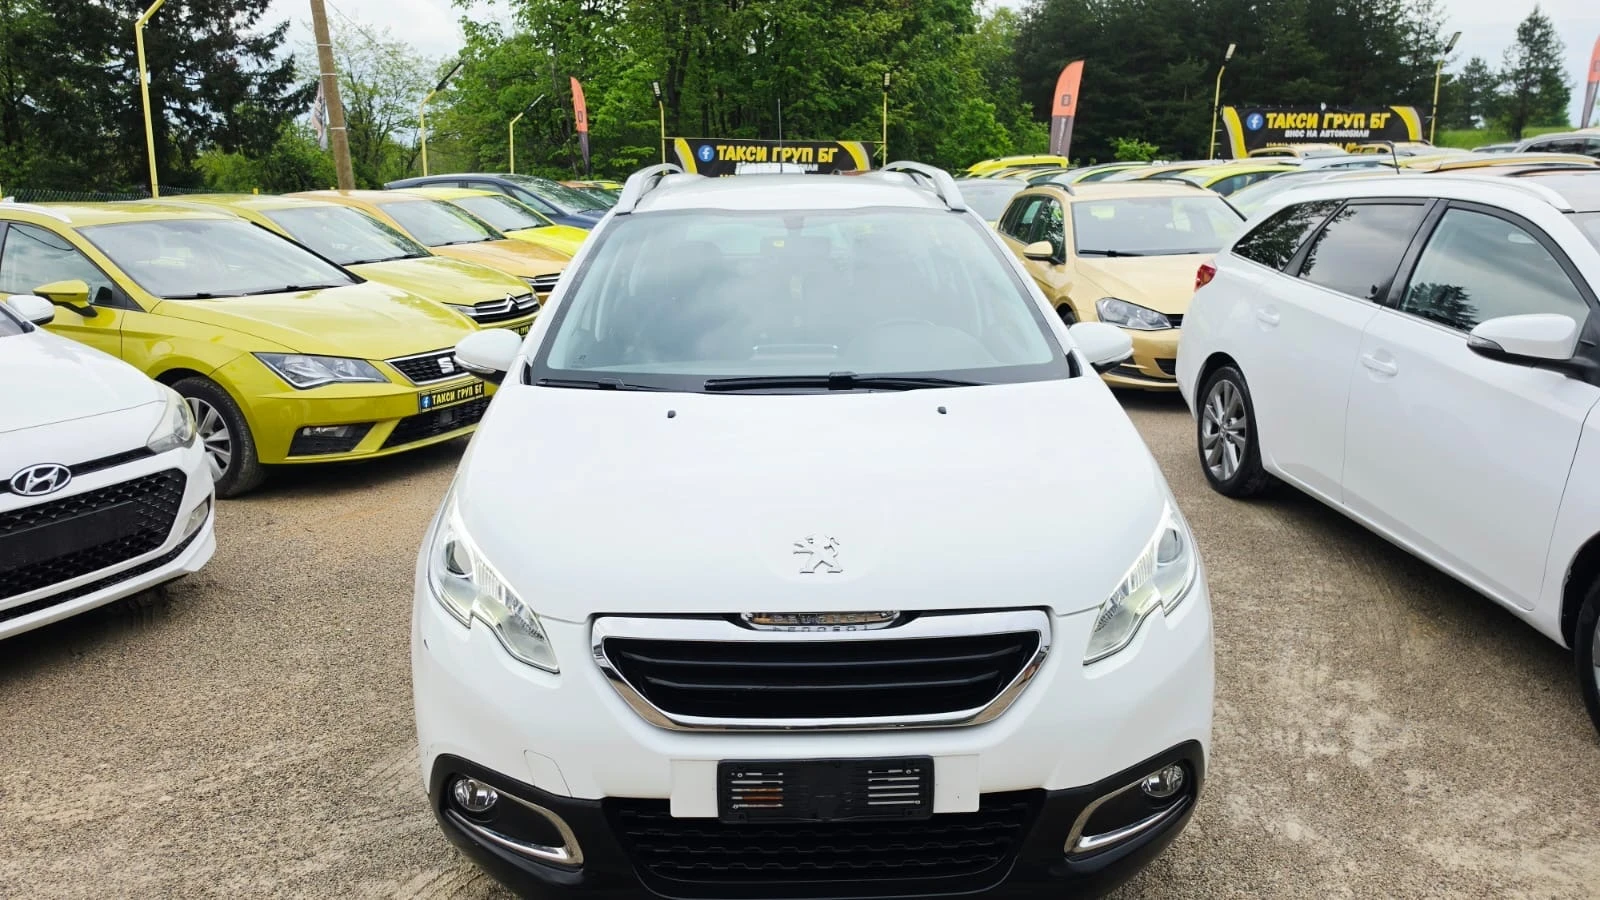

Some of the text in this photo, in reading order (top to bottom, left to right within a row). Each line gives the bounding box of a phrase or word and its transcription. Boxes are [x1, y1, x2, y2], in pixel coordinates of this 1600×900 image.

[1266, 113, 1391, 128] ТАКСИ ГРУП БГ
[1306, 130, 1318, 138] НА
[716, 145, 838, 162] ТАКСИ ГРУП БГ
[432, 384, 483, 405] ТАКСИ ГРУП БГ
